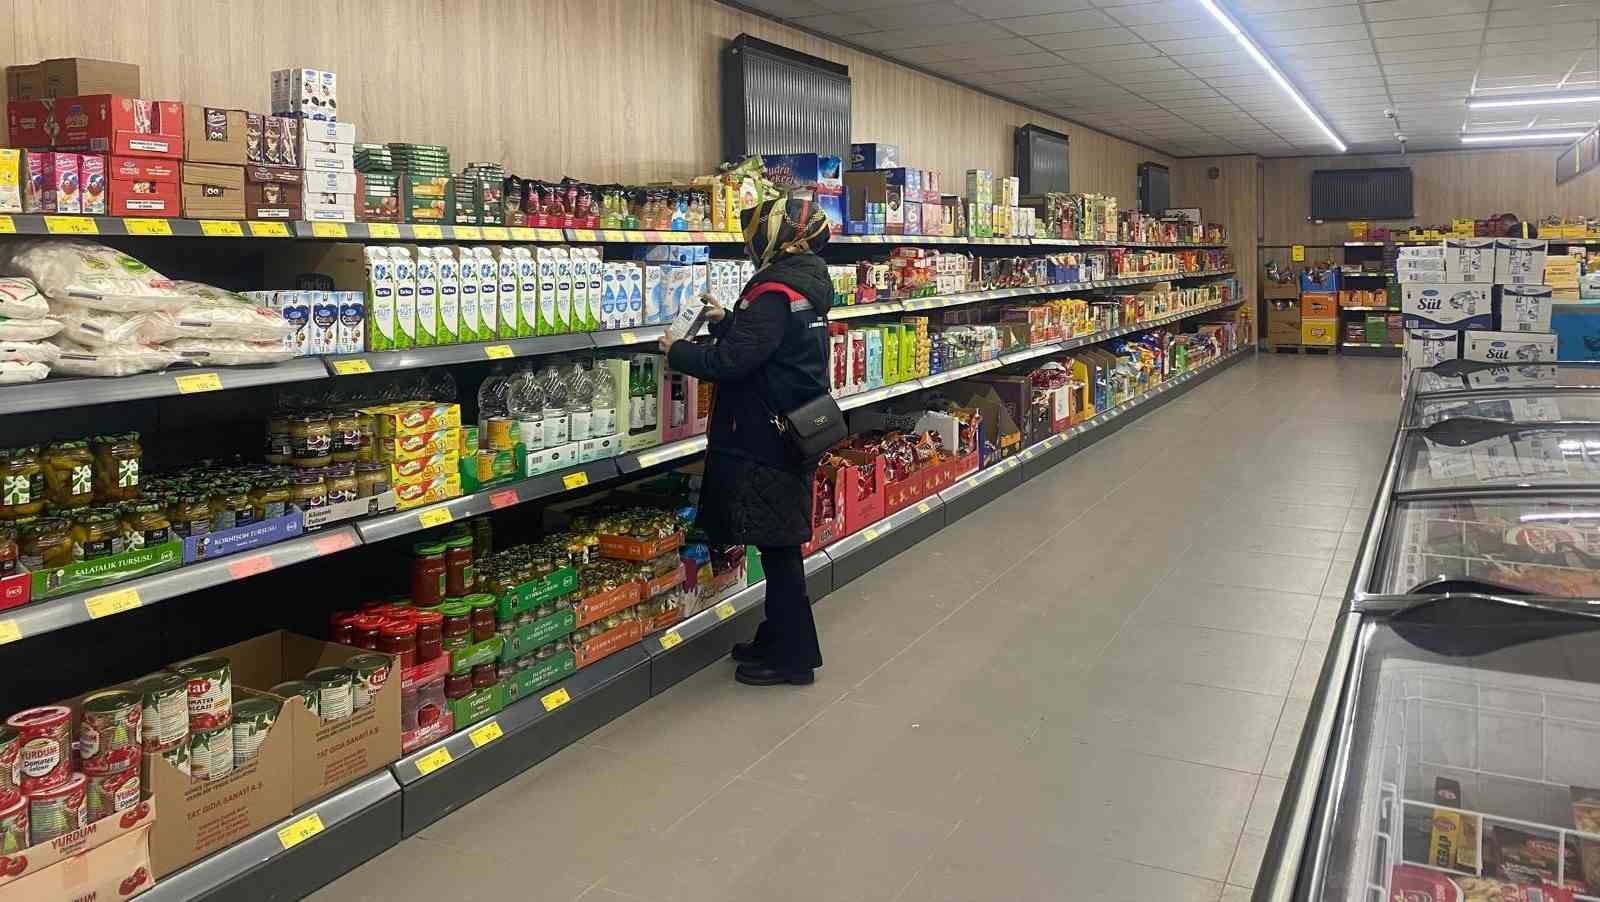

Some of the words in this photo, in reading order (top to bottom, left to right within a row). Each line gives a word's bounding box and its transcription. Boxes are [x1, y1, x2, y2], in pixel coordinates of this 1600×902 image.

[1417, 298, 1441, 310] Süt
[1486, 348, 1509, 360] Süt
[75, 561, 117, 577] SALATALIK
[20, 745, 58, 760] YURDUM
[51, 824, 96, 849] YURDUM
